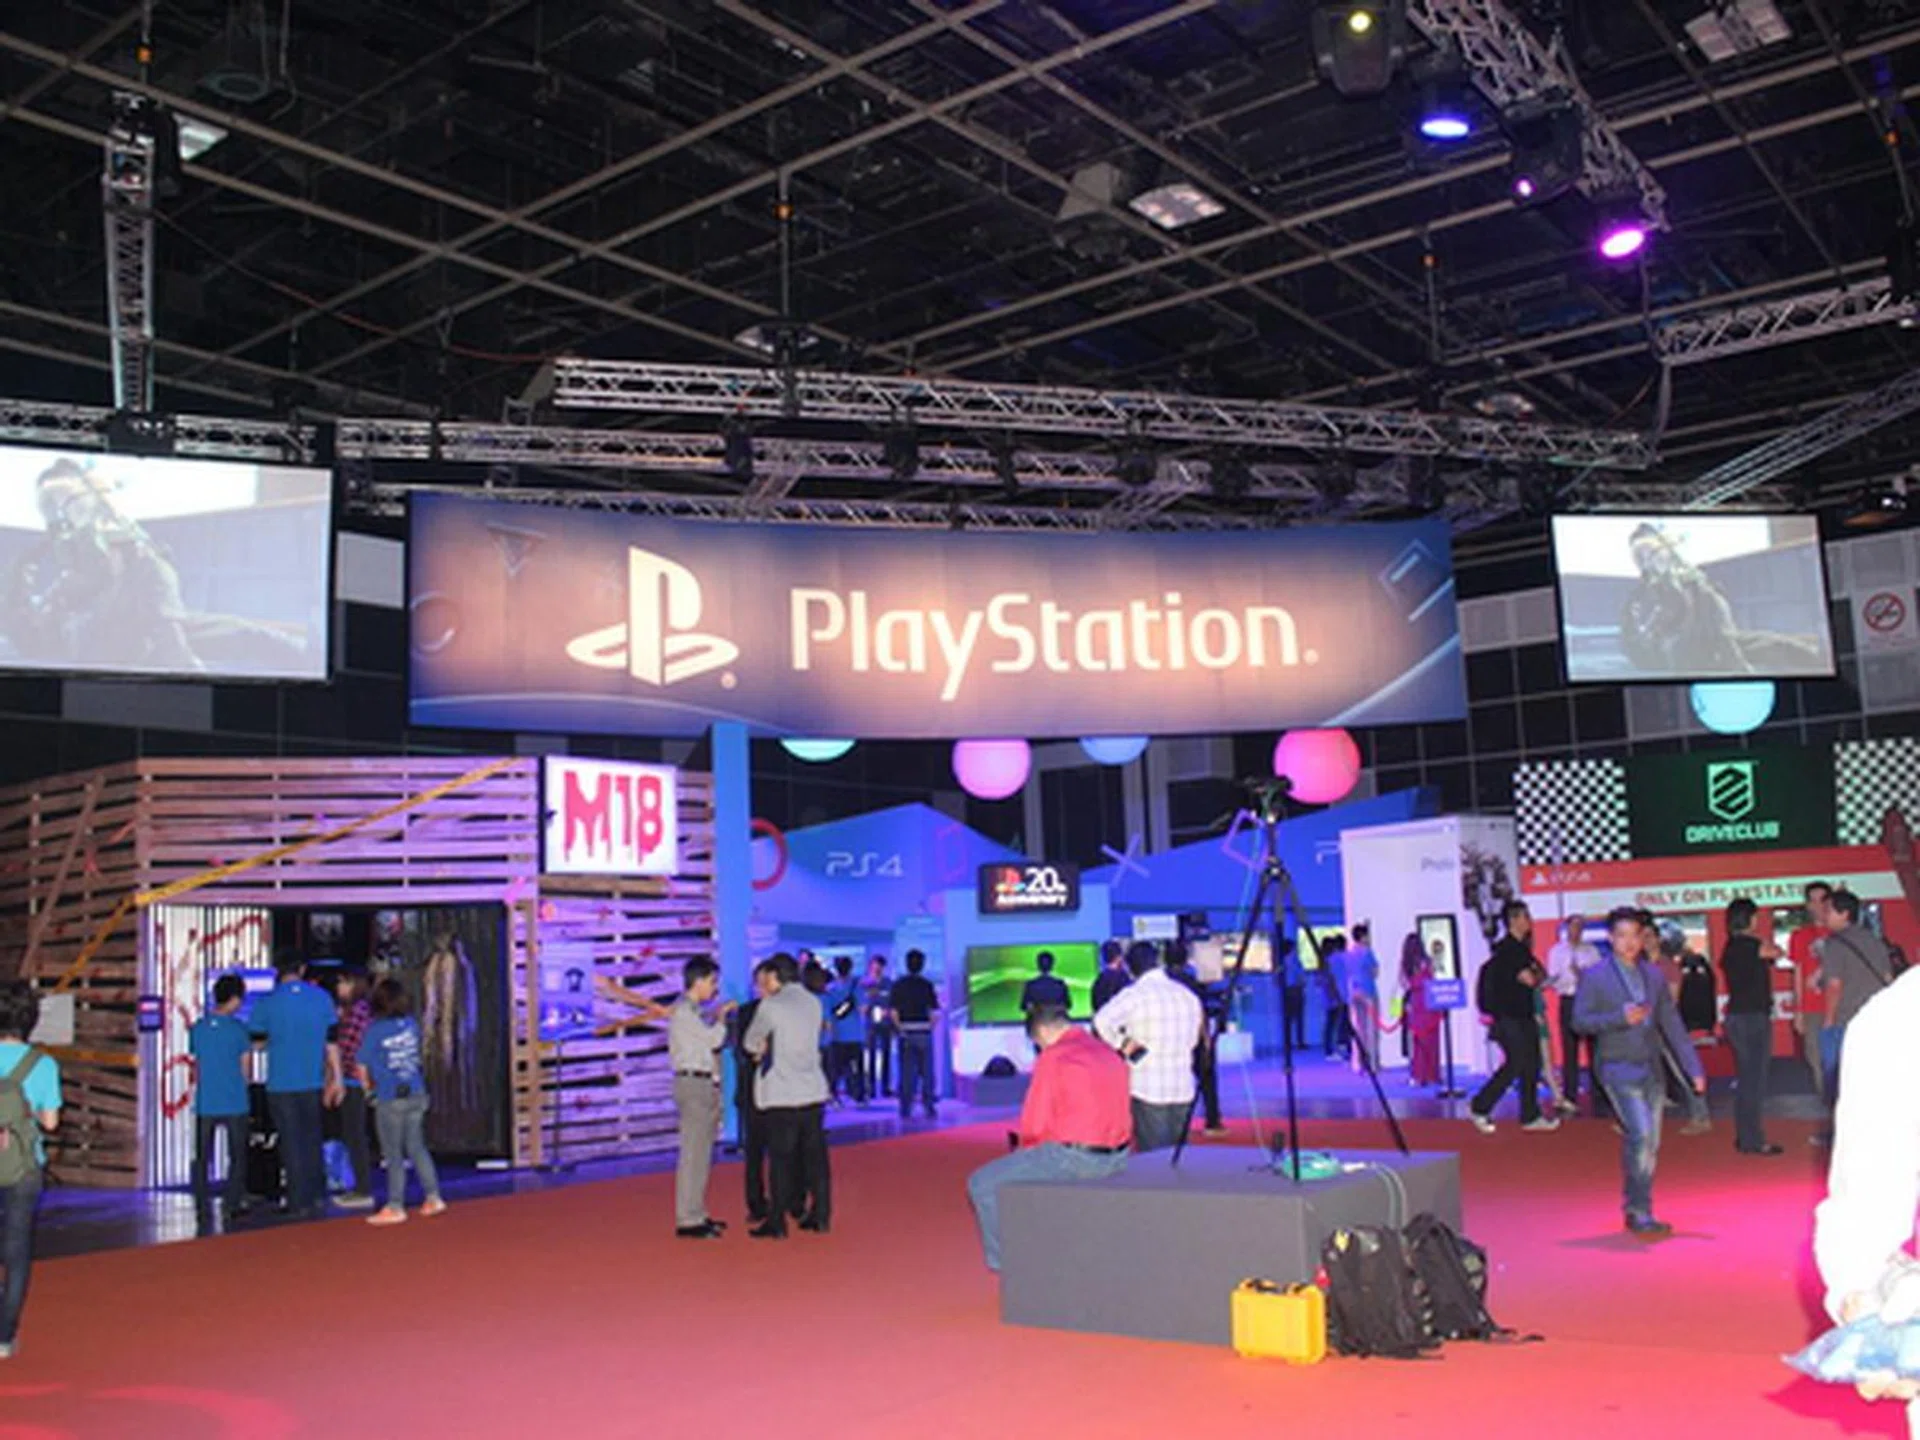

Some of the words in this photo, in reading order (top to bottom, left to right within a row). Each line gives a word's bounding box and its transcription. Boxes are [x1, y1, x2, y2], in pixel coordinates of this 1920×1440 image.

[564, 771, 663, 864] M18
[1685, 821, 1780, 844] DRIVECLUB
[825, 851, 904, 877] PS4
[1635, 891, 1677, 906] ONLY
[1683, 888, 1706, 902] ON
